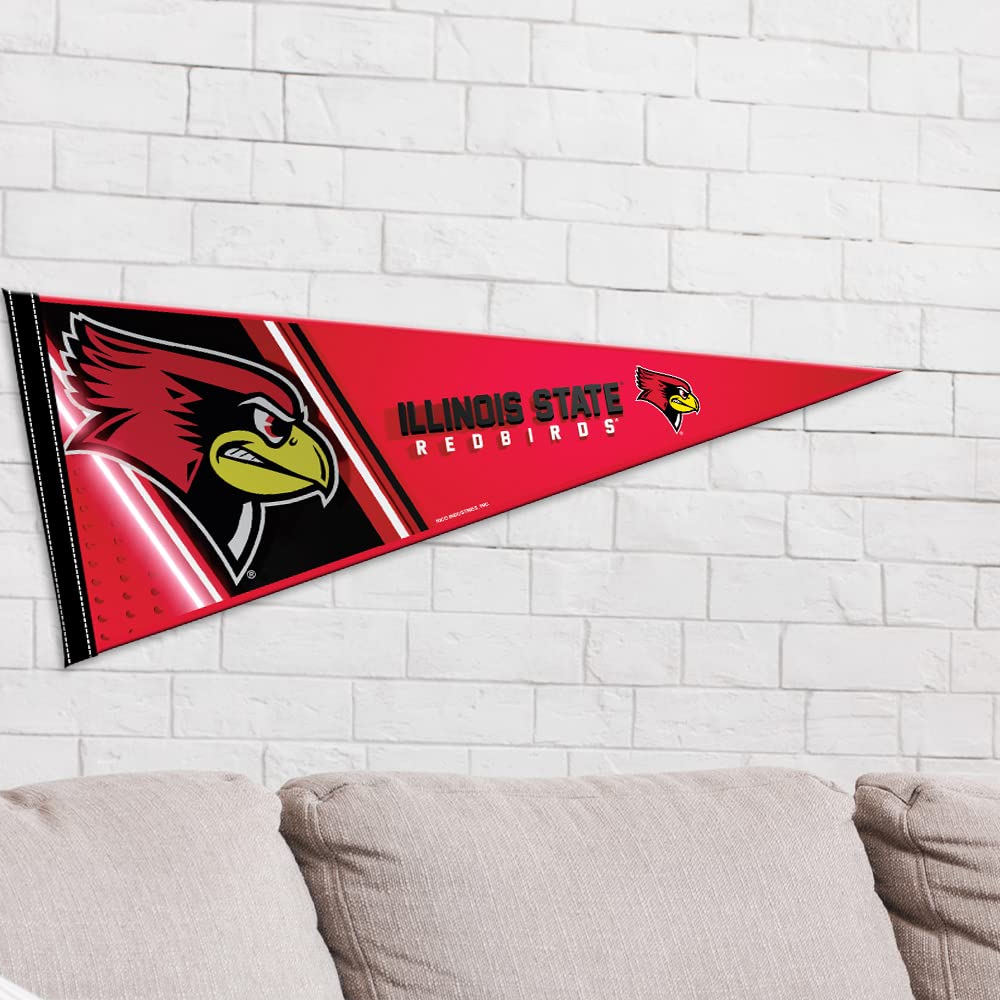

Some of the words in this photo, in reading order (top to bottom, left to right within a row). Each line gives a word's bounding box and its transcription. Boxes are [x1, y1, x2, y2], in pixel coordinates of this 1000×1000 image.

[397, 391, 524, 436] ILLINOIS
[533, 382, 623, 422] STATE
[415, 418, 616, 455] REDBIRDS
